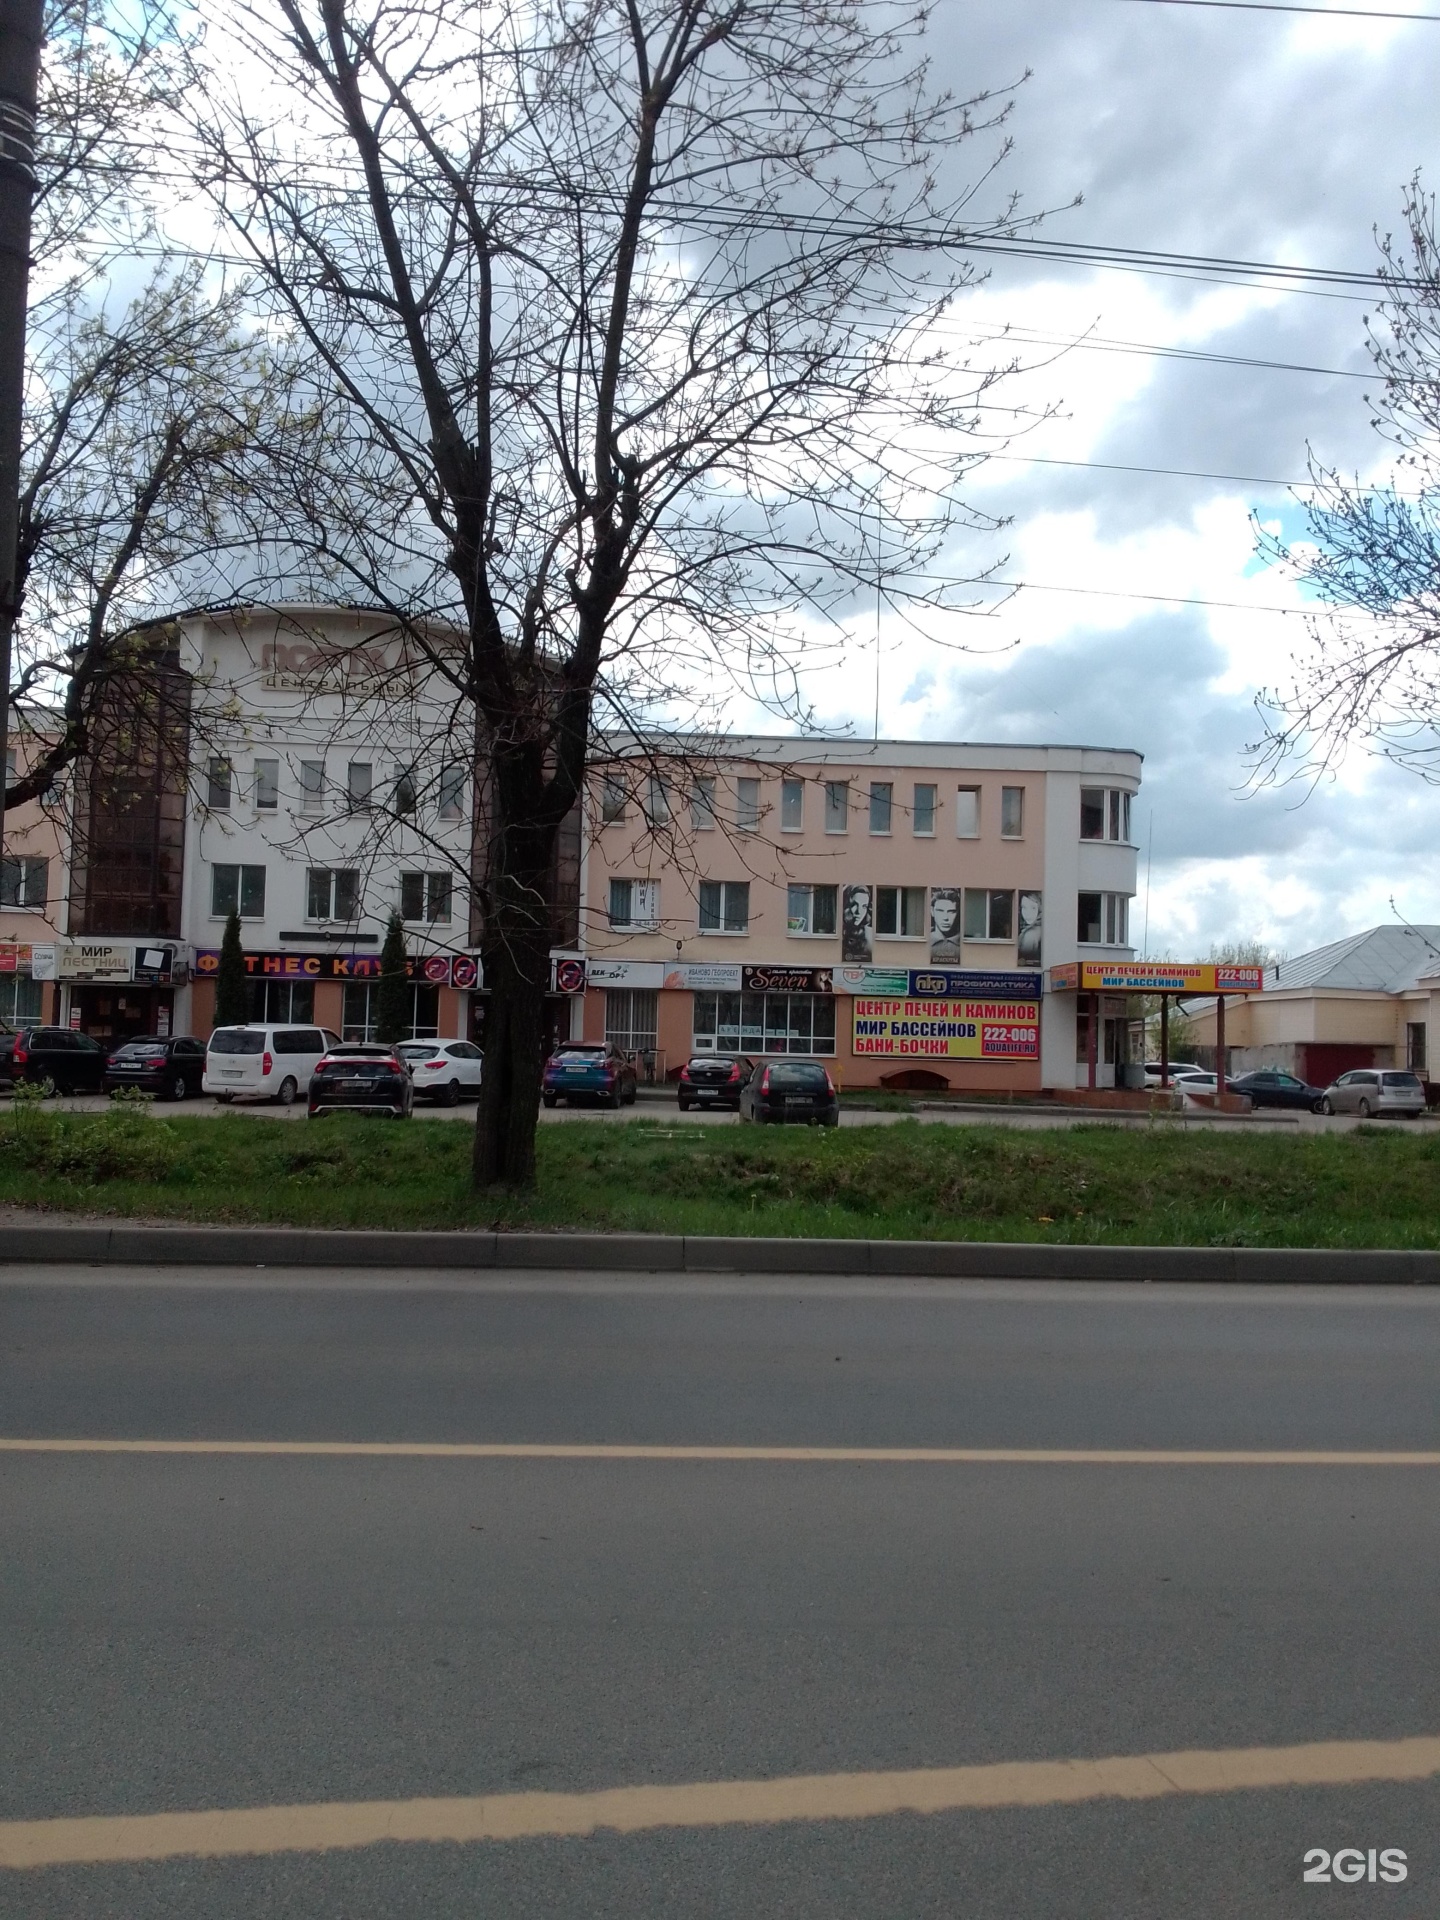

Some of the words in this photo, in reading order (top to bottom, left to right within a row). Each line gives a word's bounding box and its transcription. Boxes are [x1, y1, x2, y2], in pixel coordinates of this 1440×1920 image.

[81, 947, 113, 957] МИР
[62, 957, 128, 968] ЛЕСТНИЦ
[198, 954, 321, 975] ФТНЕС
[1086, 965, 1116, 976] ЦЕНТР
[1117, 965, 1147, 977] ПЕЧЕЙ
[1147, 968, 1154, 977] И
[1156, 967, 1202, 977] КАМИНОВ
[1217, 969, 1260, 981] 222-006
[748, 967, 809, 990] Seven
[950, 980, 1036, 989] ПРОФИЛАКТИКА
[1102, 977, 1124, 987] МИР
[1126, 977, 1185, 988] БАССЕЙНОВ
[856, 1000, 901, 1018] ЦЕНТР
[904, 1000, 949, 1018] ПЕЧЕЙ
[952, 1003, 962, 1018] И
[965, 1003, 1036, 1020] КАМИНОВ
[856, 1020, 888, 1036] МИР
[890, 1020, 977, 1038] БАССЕЙНОВ
[983, 1027, 1036, 1042] 222-006
[855, 1038, 949, 1054] БАНИ-БОЧКИ
